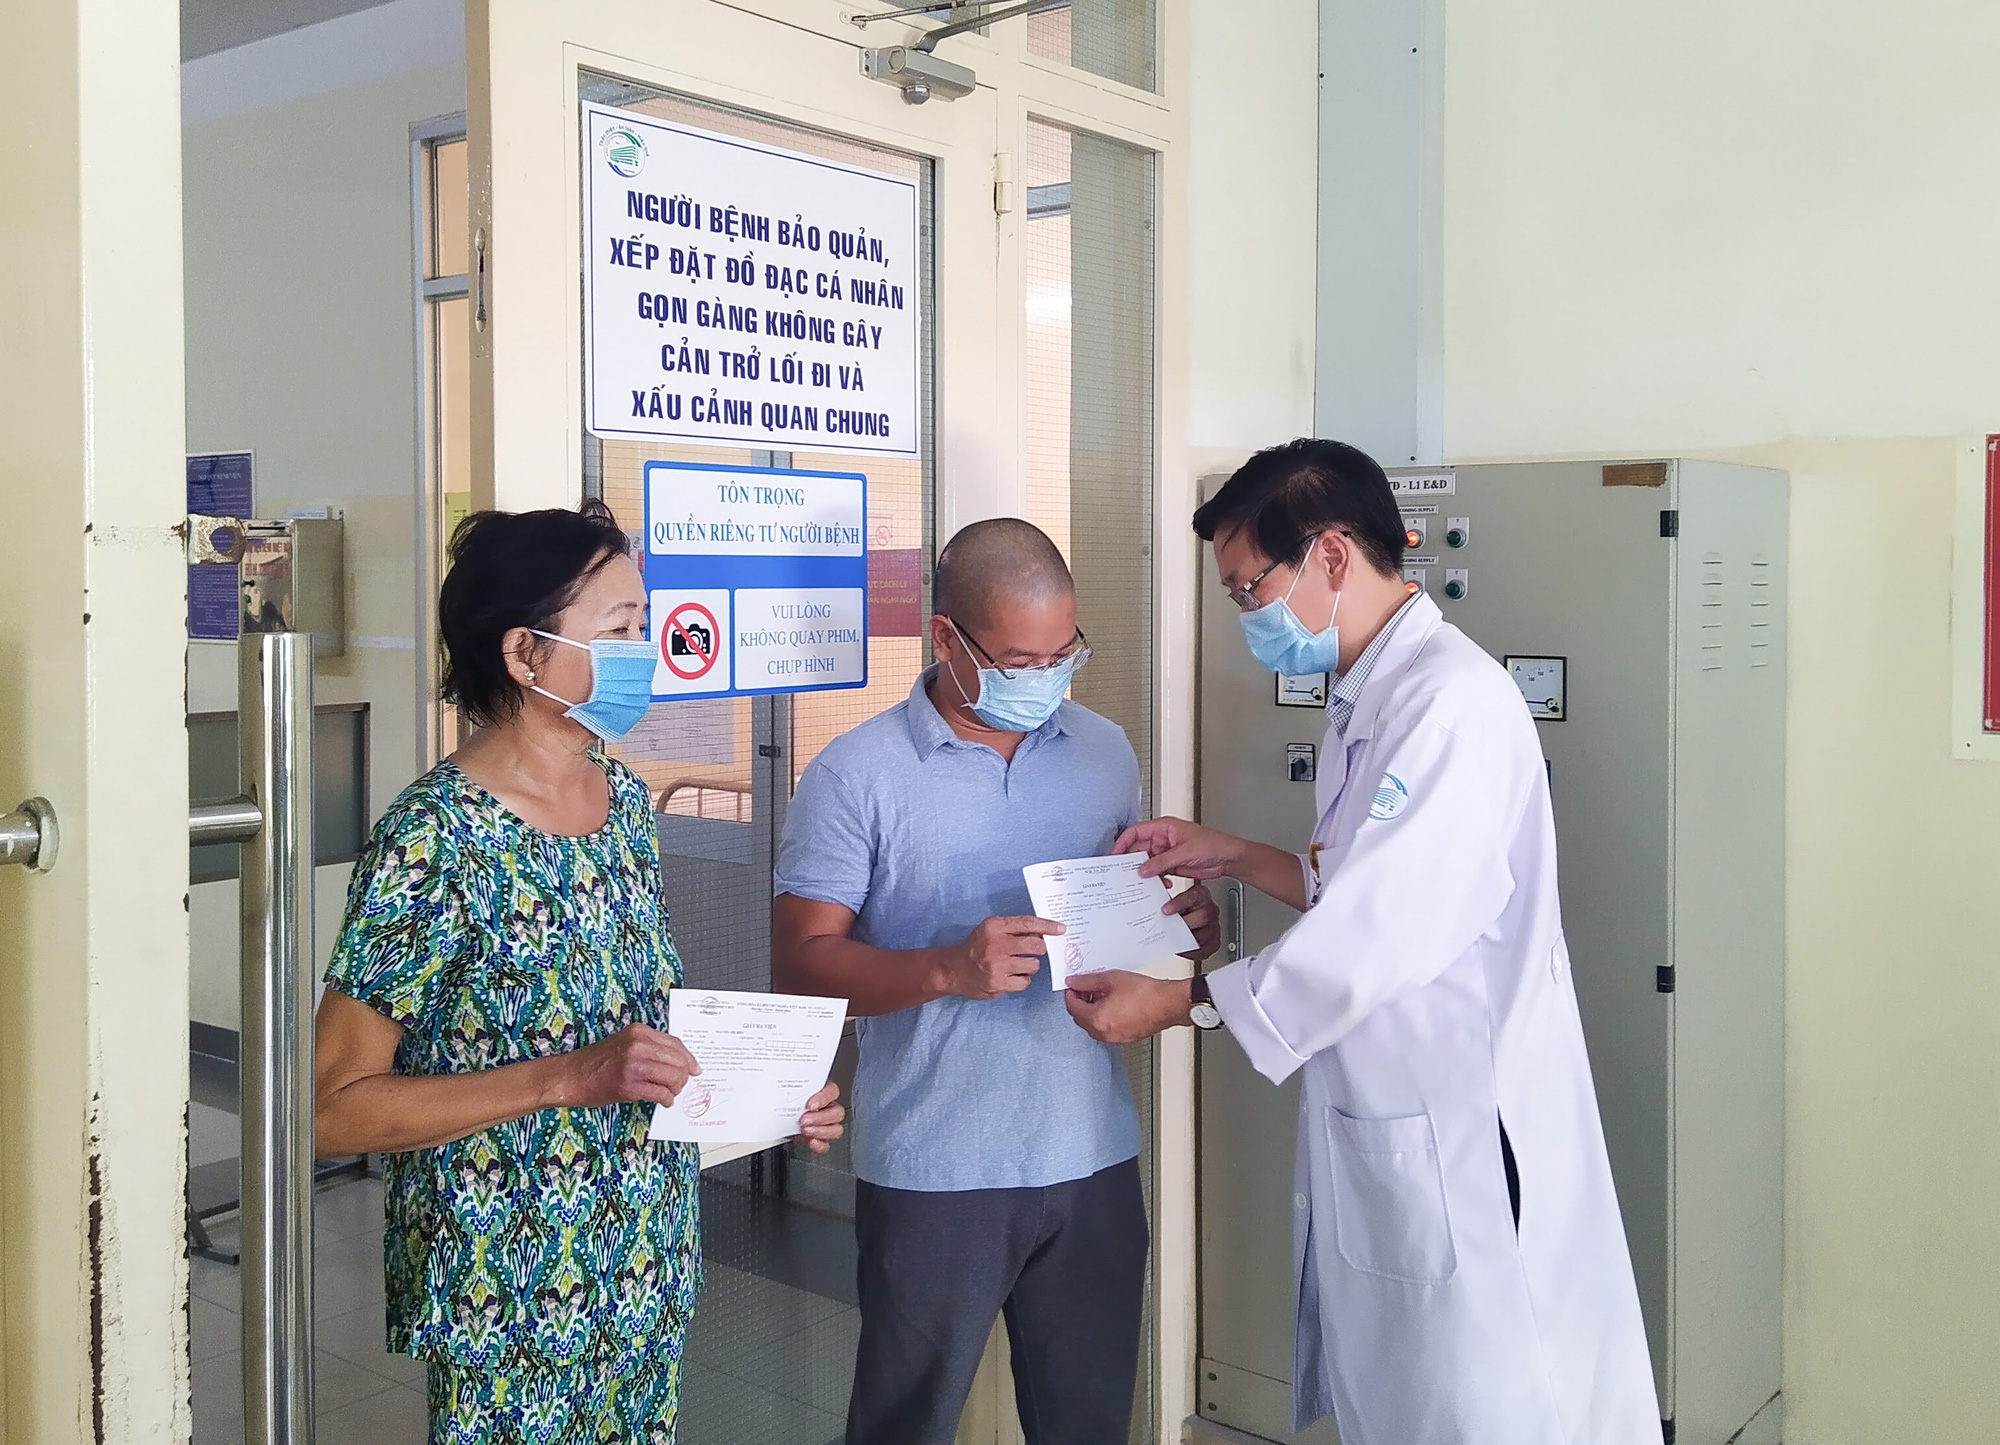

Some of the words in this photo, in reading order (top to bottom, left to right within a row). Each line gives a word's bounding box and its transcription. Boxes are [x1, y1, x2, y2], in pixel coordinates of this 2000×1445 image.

[627, 190, 701, 230] NGƯỜI
[709, 205, 770, 243] BỆNH
[778, 213, 821, 252] BẢO
[828, 226, 890, 268] QUẢN,
[610, 233, 659, 270] XẾP
[669, 245, 716, 284] ĐẶT
[725, 251, 755, 287] ĐỒ
[765, 263, 809, 299] ĐẠC
[816, 270, 842, 301] CÁ
[851, 278, 904, 310] NHÂN
[638, 292, 688, 328] GỌN
[696, 296, 758, 334] GÀNG
[765, 310, 836, 344] KHÔNG
[842, 319, 883, 350] GÂY
[661, 336, 710, 375] CẢN
[718, 345, 761, 381] TRỞ
[770, 351, 803, 386] LỐI
[811, 362, 831, 388] ĐI
[838, 361, 865, 392] VÀ
[631, 384, 682, 421] XẤU
[691, 388, 753, 427] CẢNH
[761, 402, 818, 432] QUAN
[825, 408, 890, 437] CHUNG
[718, 480, 750, 504] TÔN
[753, 486, 805, 508] TRỌNG
[1409, 480, 1420, 490] L1
[1423, 479, 1448, 490] E&D
[654, 513, 707, 545] QUYỀN
[710, 518, 755, 543] RIÊNG
[759, 522, 779, 543] TƯ
[779, 521, 823, 544] NGƯỜI
[825, 522, 860, 547] BỆNH
[772, 604, 794, 619] VUI
[796, 601, 831, 619] LÒNG
[740, 627, 787, 647] KHÔNG
[789, 629, 825, 648] QUAY
[827, 629, 860, 644] PHIM,
[767, 660, 802, 677] CHỤP
[804, 655, 835, 673] HÌNH
